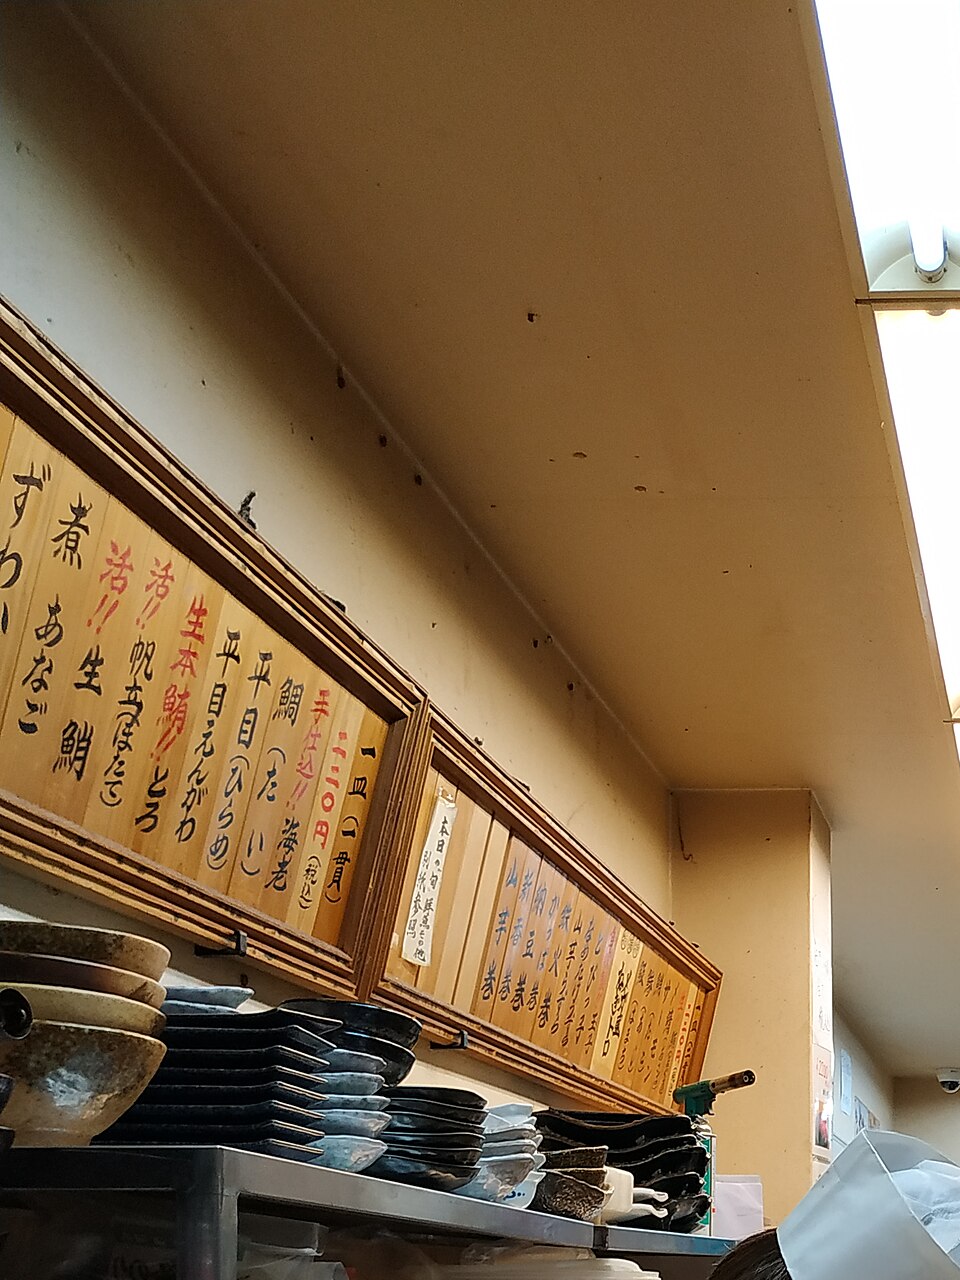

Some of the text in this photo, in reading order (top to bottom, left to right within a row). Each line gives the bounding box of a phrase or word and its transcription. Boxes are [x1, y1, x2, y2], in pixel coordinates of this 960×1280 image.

[18, 491, 94, 735] 煮あなご
[174, 626, 242, 844] 平目えんがわ
